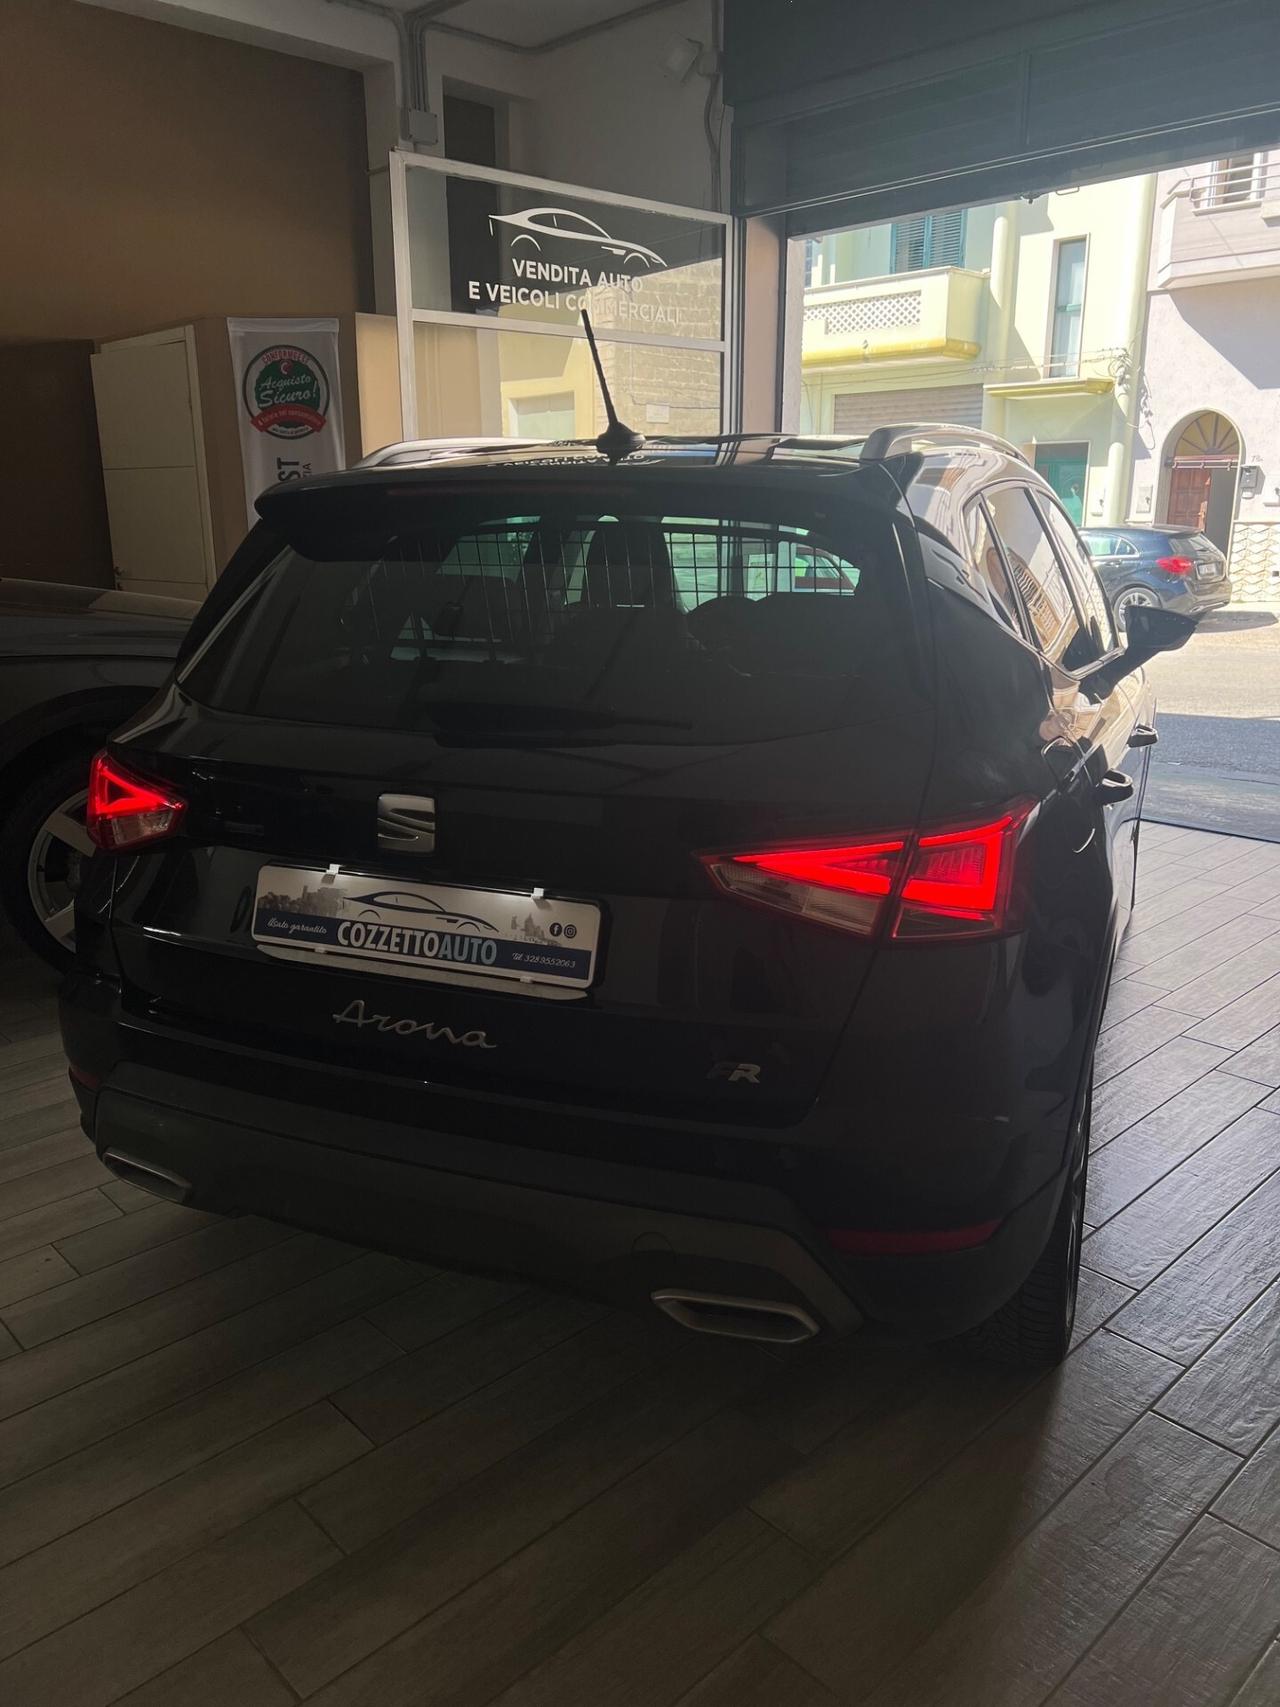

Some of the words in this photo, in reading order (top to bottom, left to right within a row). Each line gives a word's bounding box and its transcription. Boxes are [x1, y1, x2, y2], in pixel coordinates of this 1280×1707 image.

[512, 258, 592, 286] VENDITA
[597, 271, 643, 293] AUTO
[469, 281, 480, 300] E
[486, 283, 560, 310] VEICOLI
[259, 374, 311, 392] Acquisto
[259, 381, 317, 408] Sicuro!
[289, 924, 327, 935] garantito
[337, 921, 497, 965] COZZETTOAUTO
[332, 1000, 497, 1048] Arona
